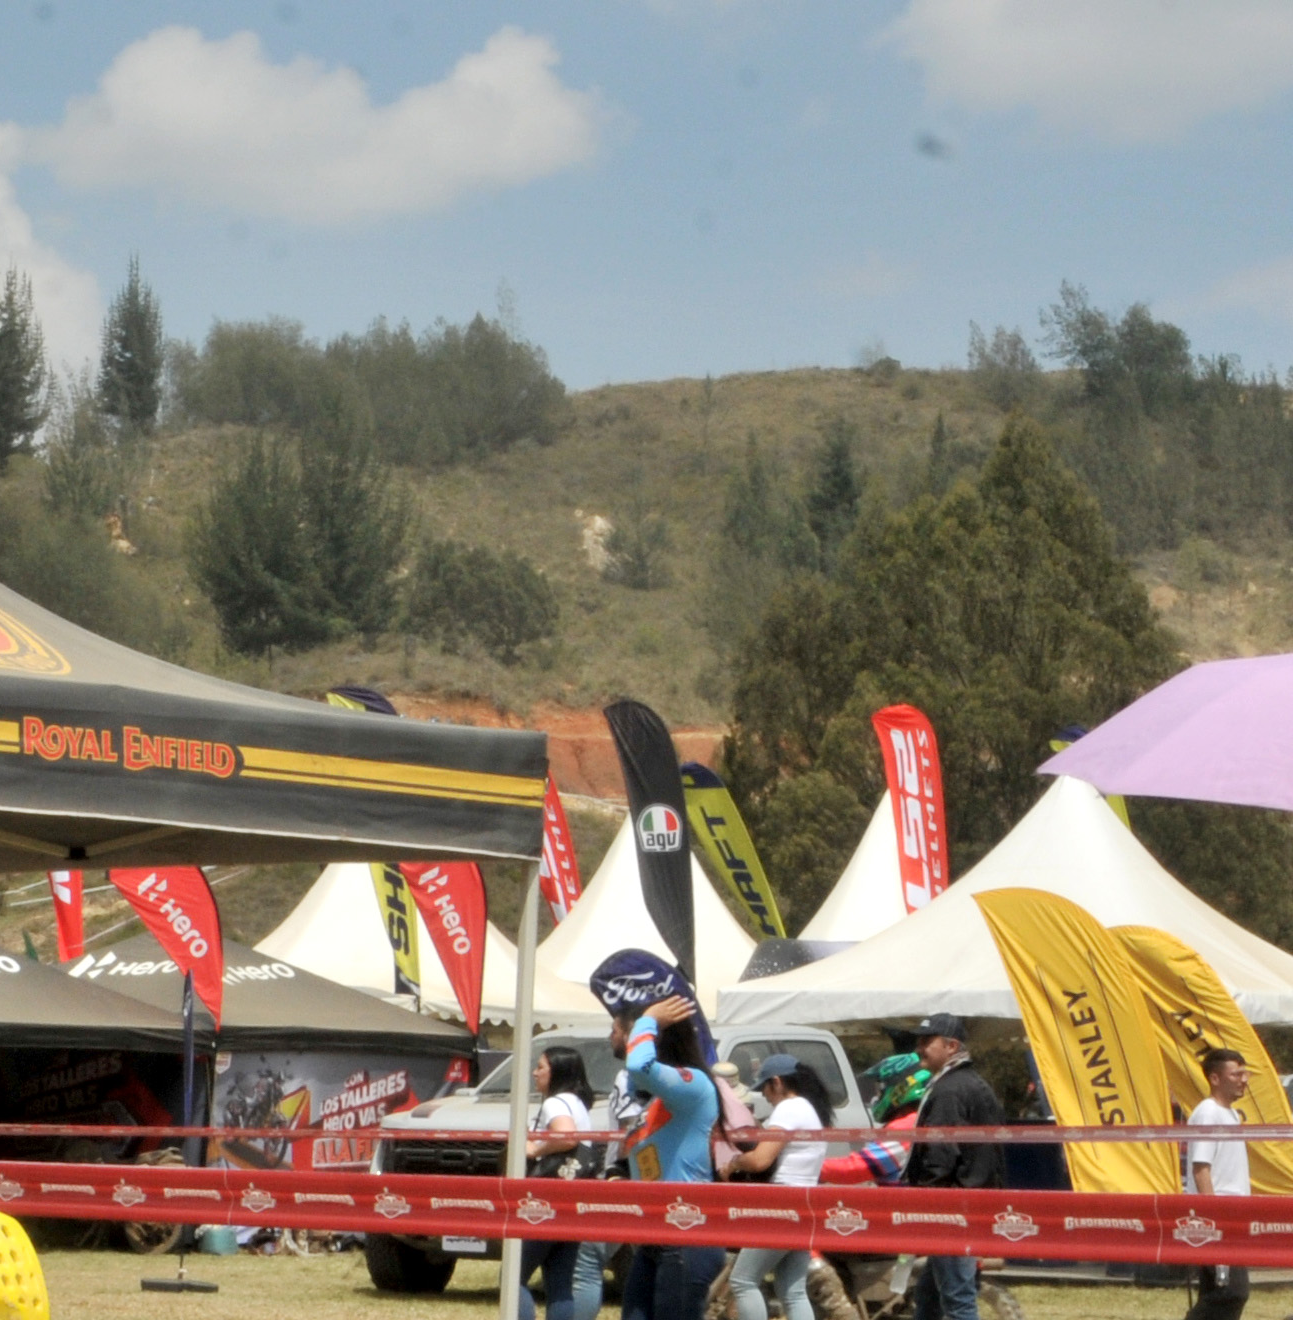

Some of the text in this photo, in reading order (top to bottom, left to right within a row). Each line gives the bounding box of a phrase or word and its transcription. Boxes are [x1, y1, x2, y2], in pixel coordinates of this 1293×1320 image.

[22, 715, 236, 779] ROYAL ENFIELD
[645, 830, 677, 851] agv
[159, 897, 209, 959] Hero
[433, 894, 472, 955] Hero
[602, 970, 675, 1006] Ford
[1063, 985, 1126, 1126] STANLEY
[340, 1071, 408, 1112] TALLERES
